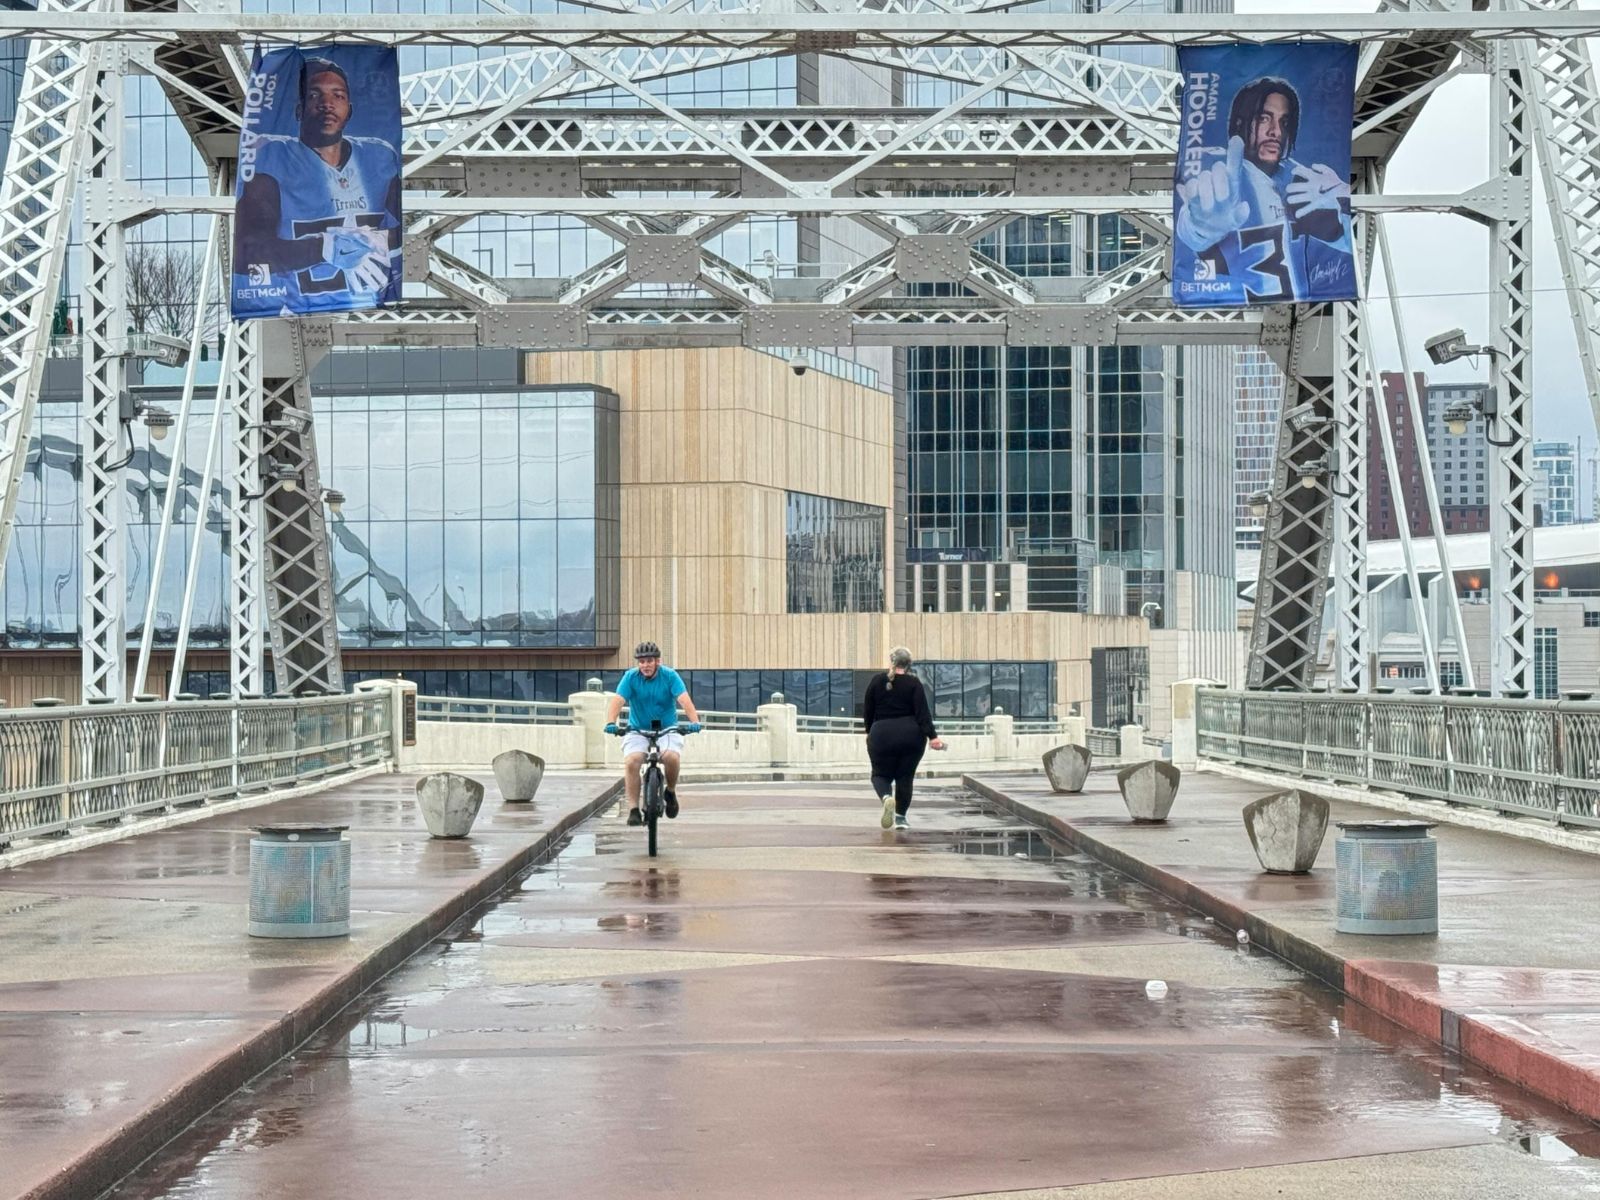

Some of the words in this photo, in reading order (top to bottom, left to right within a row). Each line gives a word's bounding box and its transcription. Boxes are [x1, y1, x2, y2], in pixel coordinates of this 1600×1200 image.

[264, 73, 278, 111] TONY
[1206, 72, 1220, 121] AMANI
[240, 73, 267, 183] POLLARD
[1184, 72, 1209, 177] HOOKER
[237, 286, 287, 299] BETMGM
[1181, 281, 1231, 293] BETMGM
